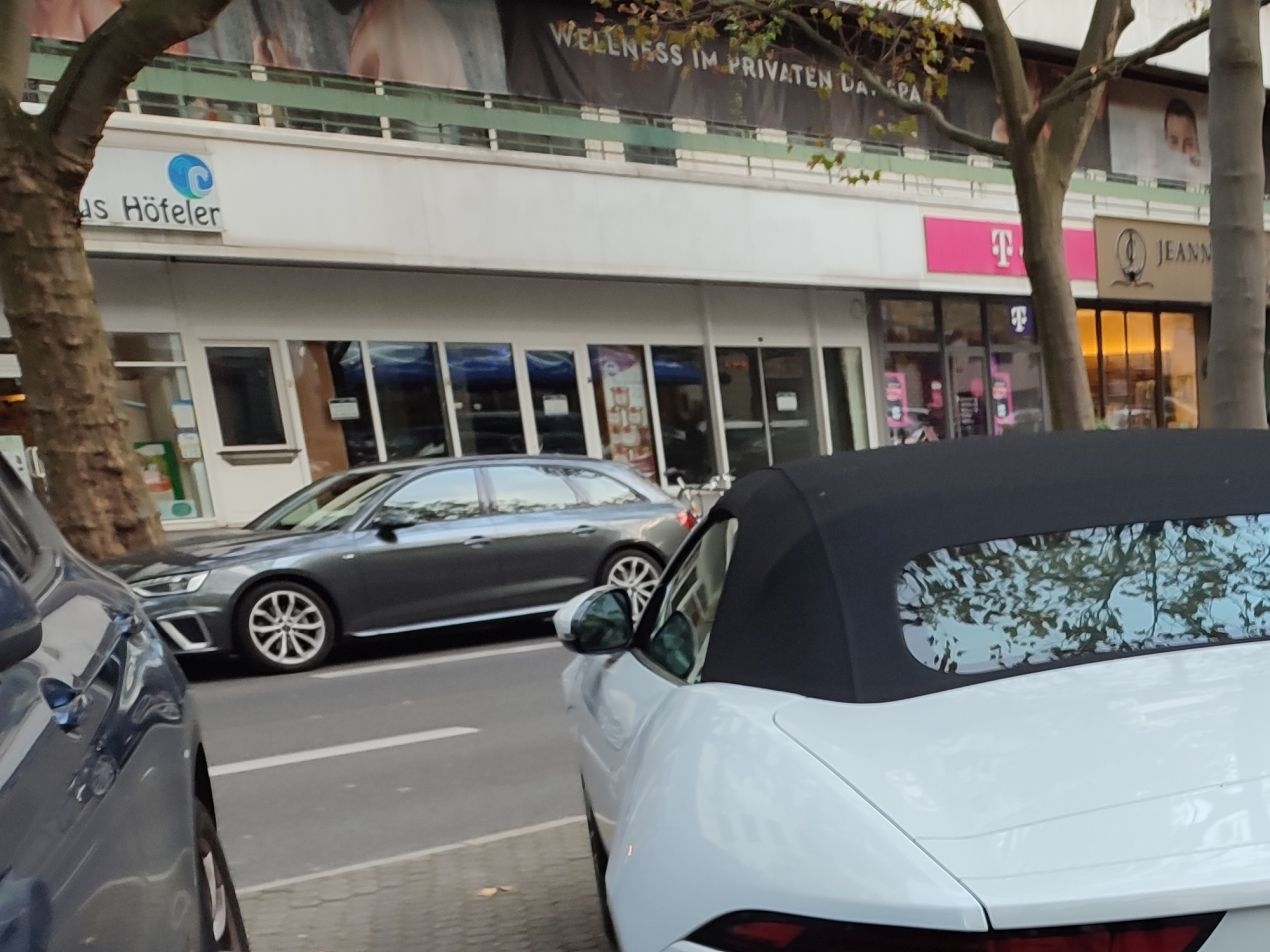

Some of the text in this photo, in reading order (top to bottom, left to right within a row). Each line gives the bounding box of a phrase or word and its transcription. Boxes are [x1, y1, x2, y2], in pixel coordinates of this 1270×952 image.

[548, 22, 684, 67] WELLNESS
[691, 40, 719, 71] IM
[728, 54, 833, 89] PRIVATEN
[840, 72, 880, 97] DA
[80, 195, 221, 226] us Höfeler
[1156, 239, 1212, 266] JEANN
